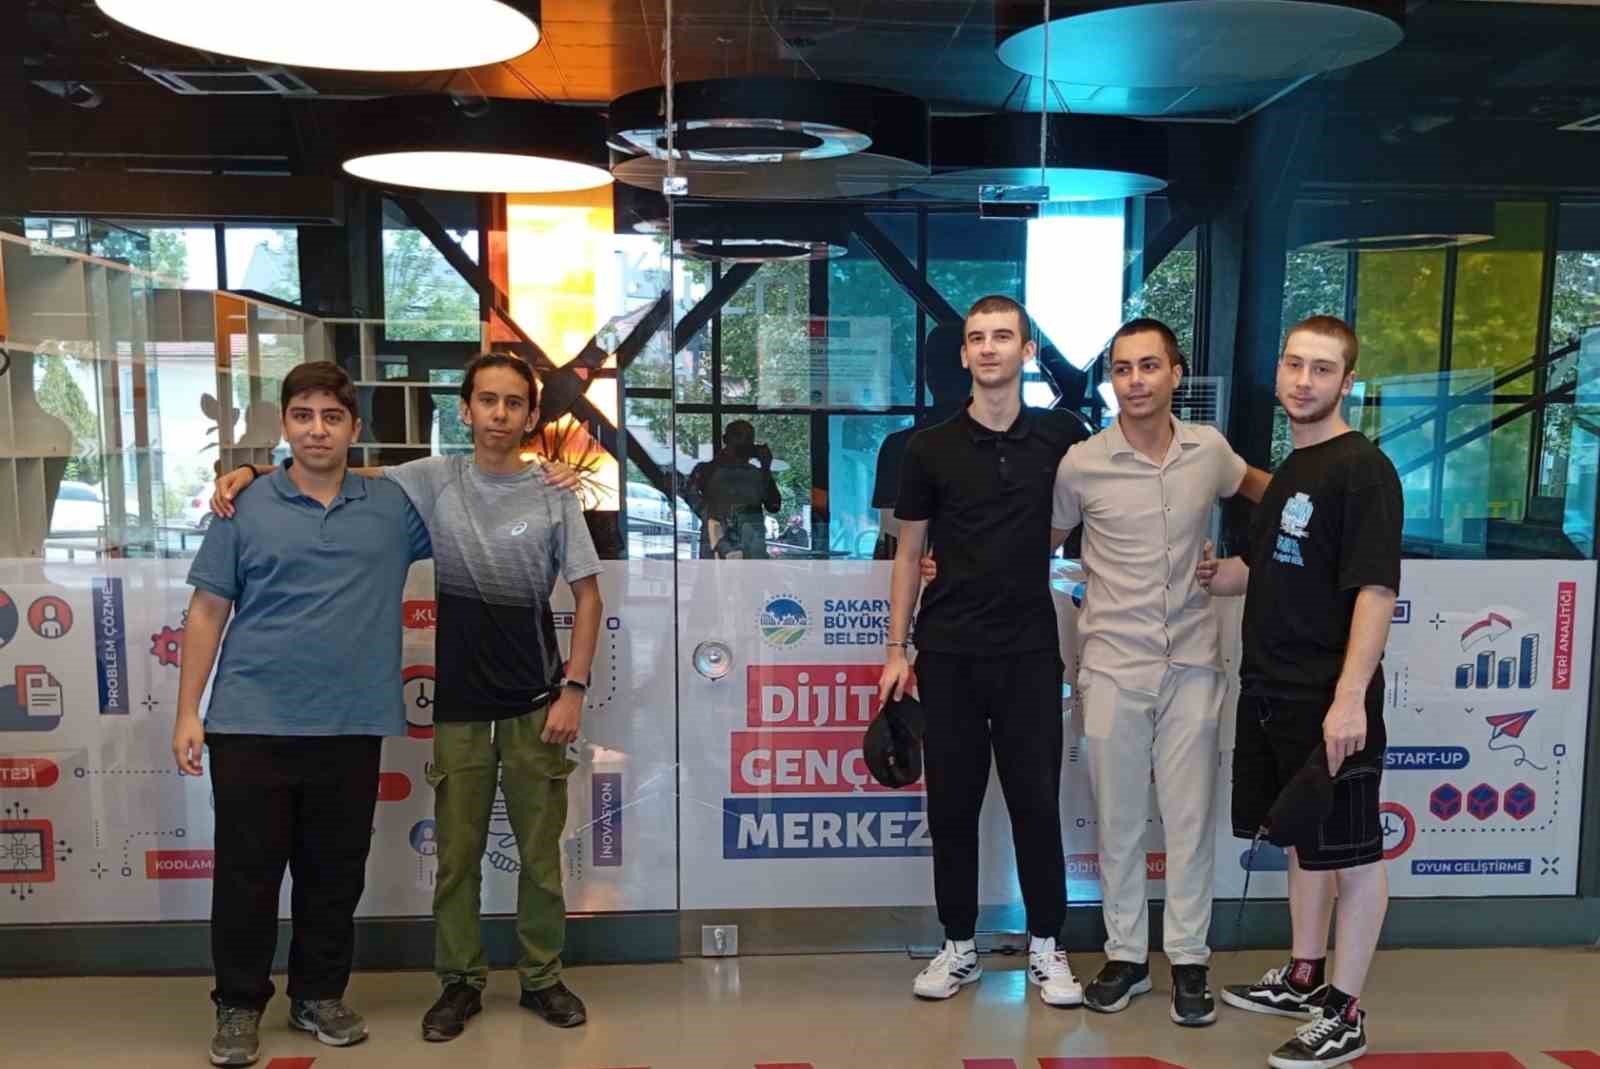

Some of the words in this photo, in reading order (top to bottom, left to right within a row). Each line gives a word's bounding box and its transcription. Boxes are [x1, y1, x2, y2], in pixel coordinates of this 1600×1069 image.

[824, 631, 888, 645] BELEDİ
[105, 640, 119, 707] PROBLEM
[1556, 654, 1568, 684] VERİ
[762, 672, 880, 727] DİJİT
[1386, 752, 1463, 765] START-UP
[741, 749, 880, 792] GENÇ
[155, 859, 214, 871] KODLAM
[1416, 862, 1452, 873] OYUN
[1454, 859, 1526, 875] GELİŞTİRME
